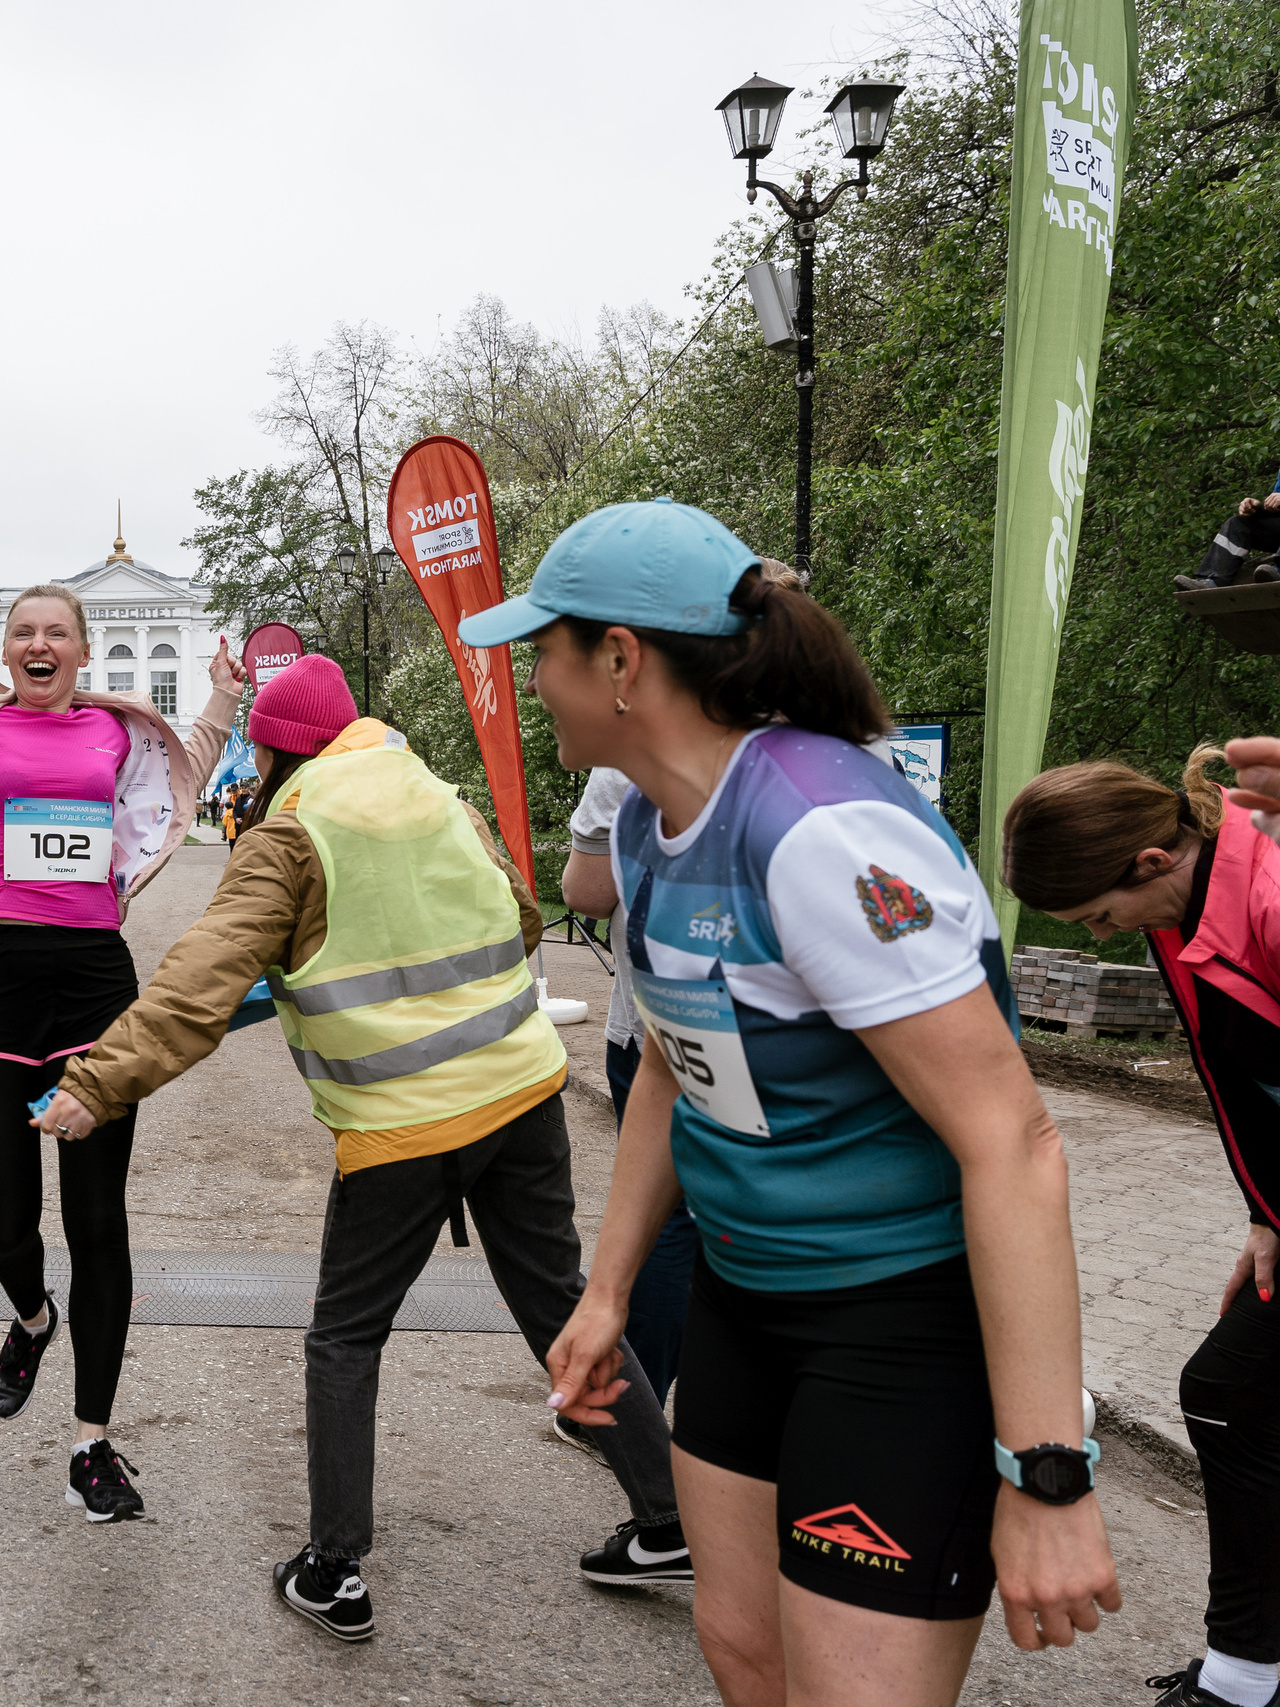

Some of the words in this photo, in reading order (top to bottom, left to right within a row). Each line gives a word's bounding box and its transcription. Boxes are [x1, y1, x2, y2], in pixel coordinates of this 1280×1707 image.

[89, 608, 175, 619] ИВЕРСИТЕТ
[50, 804, 89, 812] ТАМАНСКАЯ
[30, 833, 91, 860] 102
[792, 1528, 831, 1554] NIKE
[842, 1547, 905, 1573] TRAIL
[345, 1581, 362, 1594] NIKE
